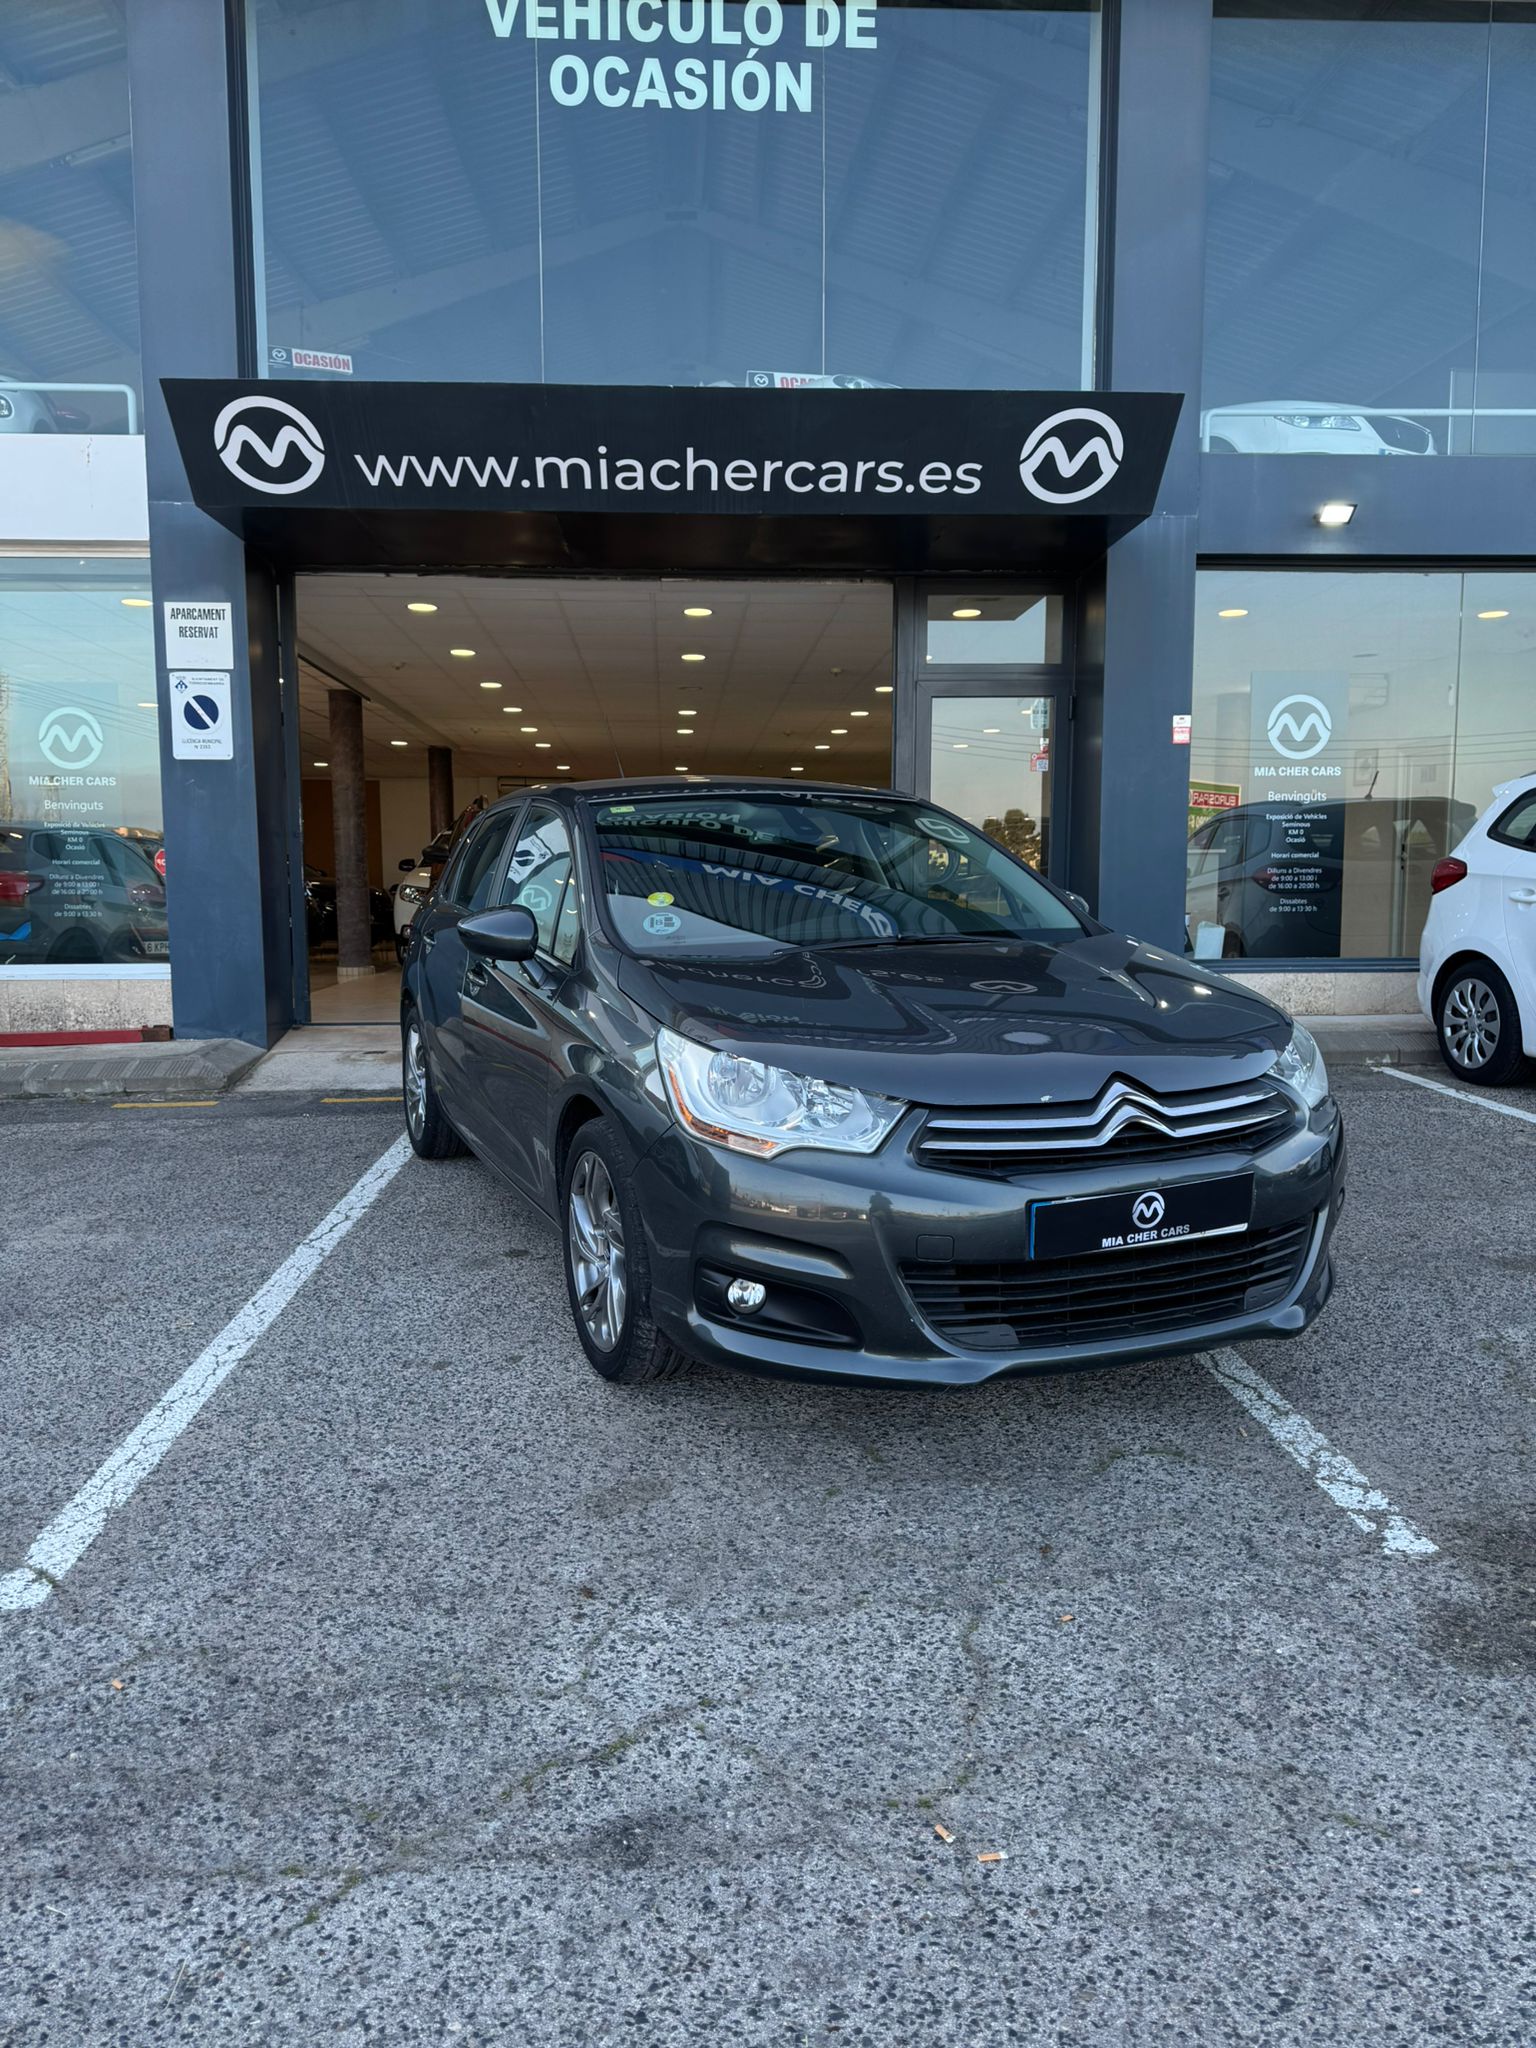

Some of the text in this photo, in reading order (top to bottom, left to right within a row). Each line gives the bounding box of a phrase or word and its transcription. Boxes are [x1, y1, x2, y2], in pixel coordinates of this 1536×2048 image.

[805, 0, 878, 49] DE
[549, 48, 812, 113] OCASIÓN
[294, 352, 351, 371] OCASIÓN
[354, 446, 983, 495] www.miachercars.es
[170, 608, 226, 620] APARCAMENT
[179, 626, 218, 639] RESERVAT
[1254, 766, 1342, 776] MIA CHER CARS
[53, 776, 84, 786] CHER
[86, 776, 116, 786] CARS
[44, 800, 104, 813] Benvinguts
[1102, 1224, 1190, 1248] MIA CHER CARS
